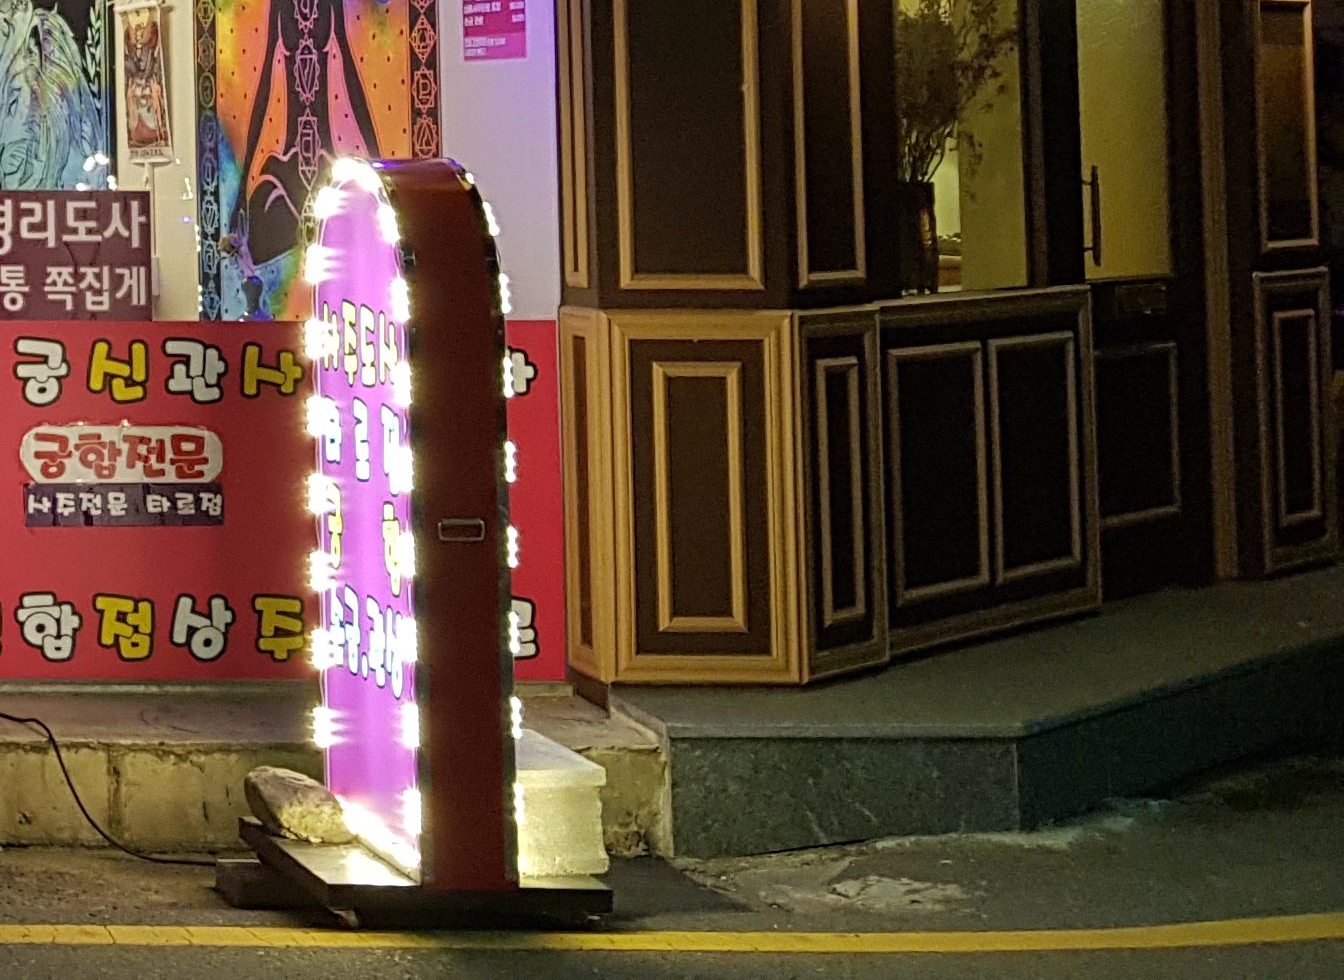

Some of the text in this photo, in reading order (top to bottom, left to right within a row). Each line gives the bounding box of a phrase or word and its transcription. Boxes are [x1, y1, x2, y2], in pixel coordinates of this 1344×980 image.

[43, 263, 149, 312] 쪽집게
[33, 432, 210, 479] 궁합전문
[28, 492, 223, 517] 사주전문 타로점
